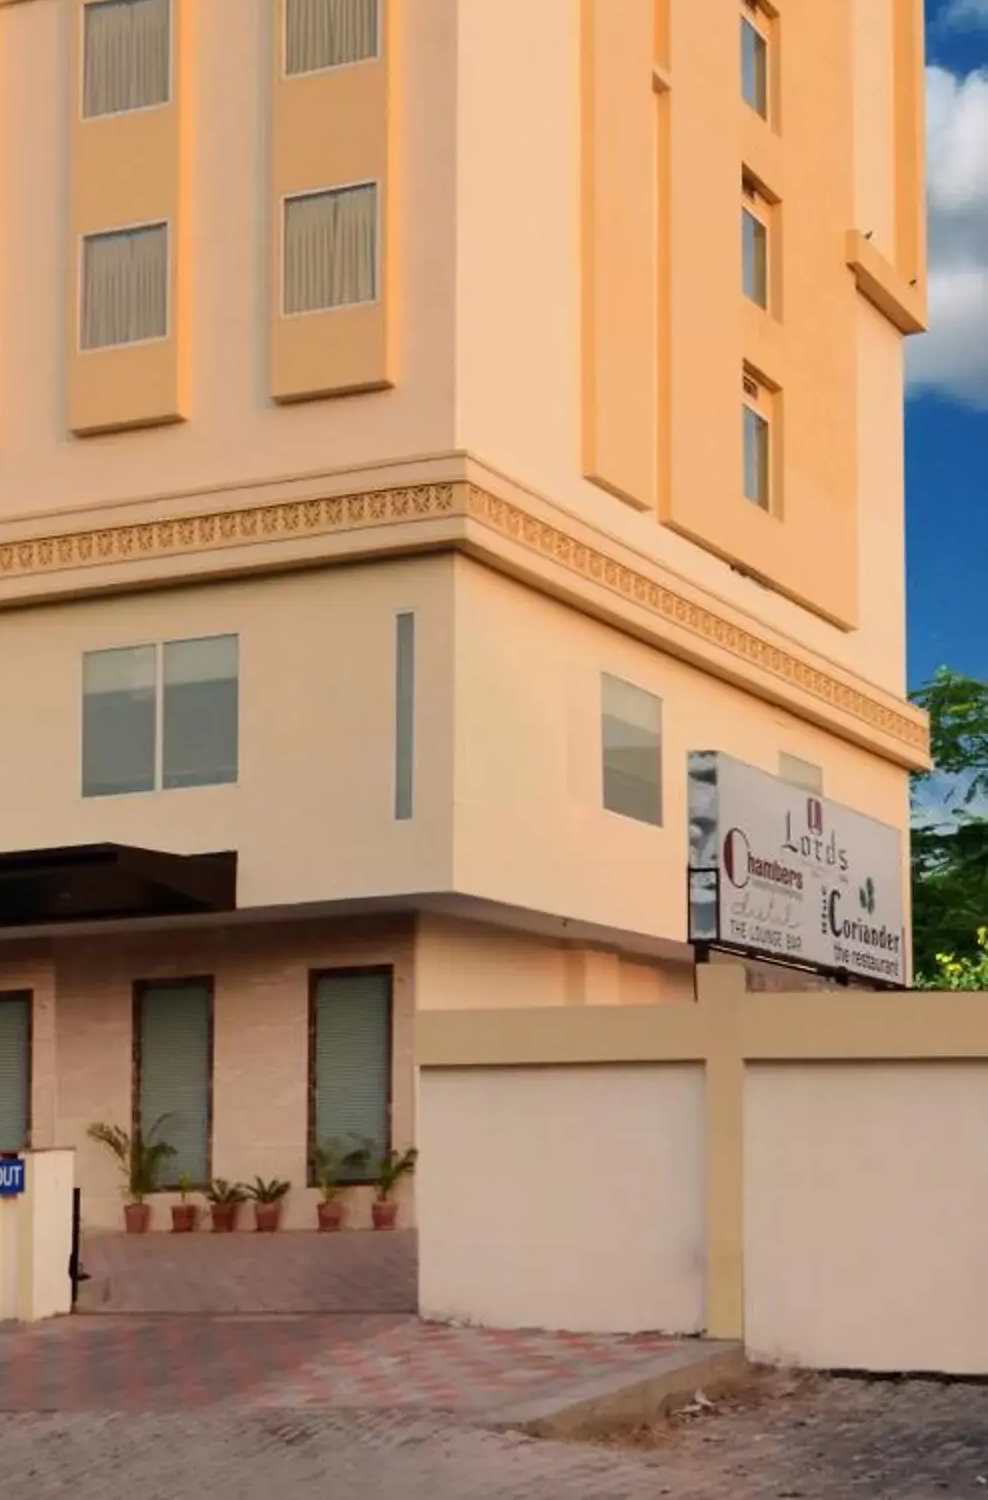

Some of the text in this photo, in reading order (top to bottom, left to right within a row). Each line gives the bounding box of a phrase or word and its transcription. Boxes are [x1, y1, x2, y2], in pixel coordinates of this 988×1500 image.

[723, 828, 803, 890] Chambers
[781, 810, 849, 871] Lords
[730, 918, 803, 951] THE LOUNGE BAR
[828, 888, 900, 954] Coriander
